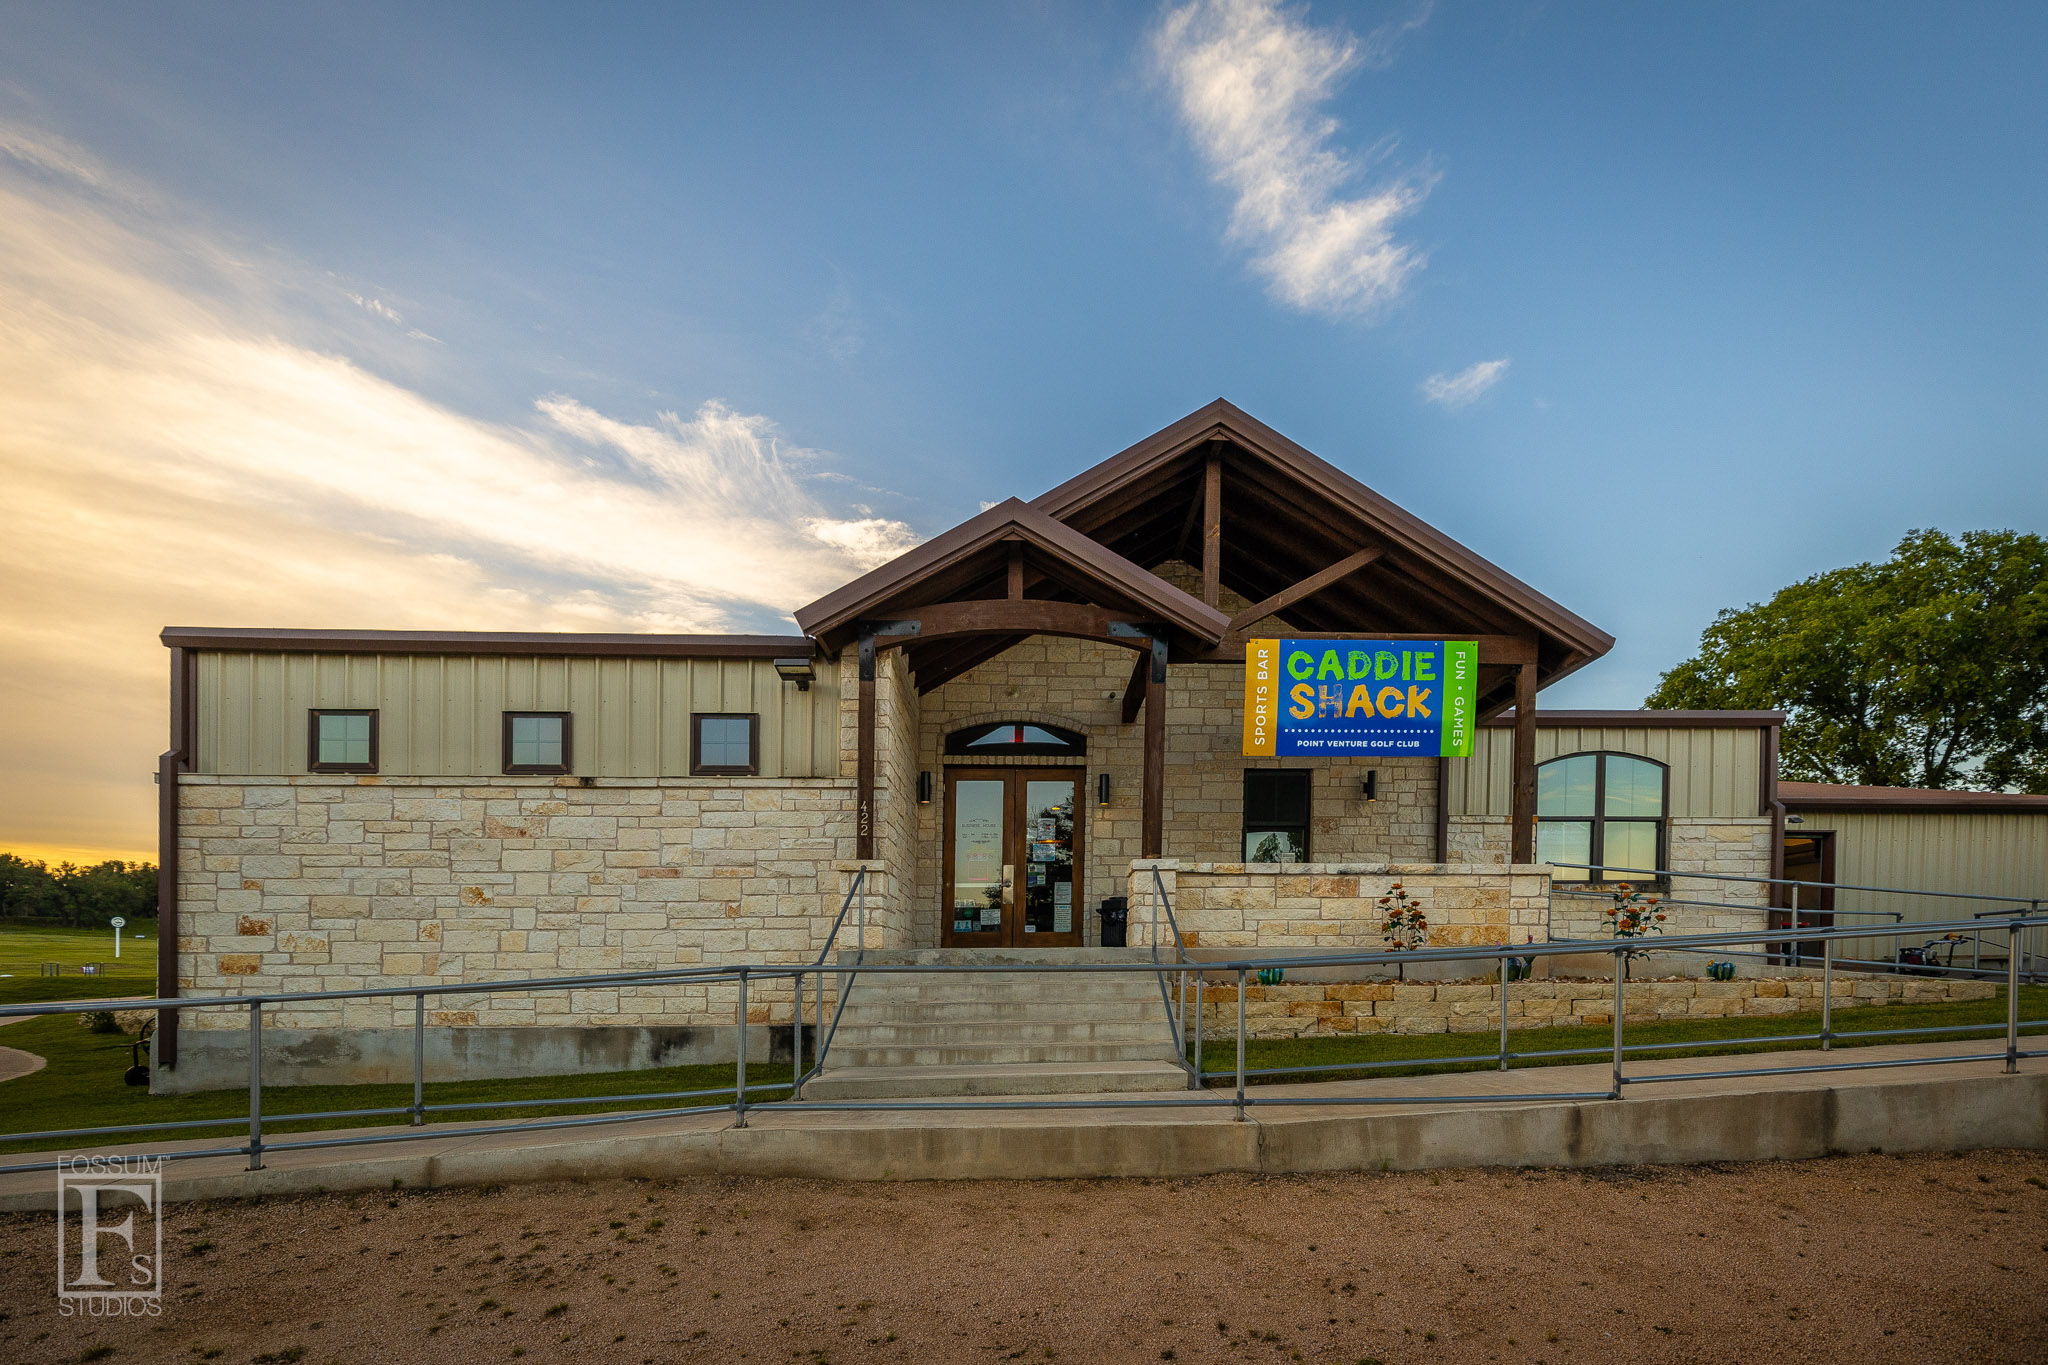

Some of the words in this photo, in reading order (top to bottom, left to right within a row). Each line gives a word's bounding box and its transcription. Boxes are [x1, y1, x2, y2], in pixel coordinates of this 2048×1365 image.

[1257, 649, 1269, 680] BAR
[1287, 649, 1436, 681] CADDIE
[1455, 651, 1466, 680] FUN
[1255, 686, 1268, 746] SPORTS
[1288, 683, 1432, 720] SHACK
[1452, 696, 1465, 747] GAMES
[1327, 740, 1368, 748] VENTURE
[1370, 740, 1394, 748] GOLF
[1396, 740, 1420, 748] CLUB
[861, 800, 869, 836] 422
